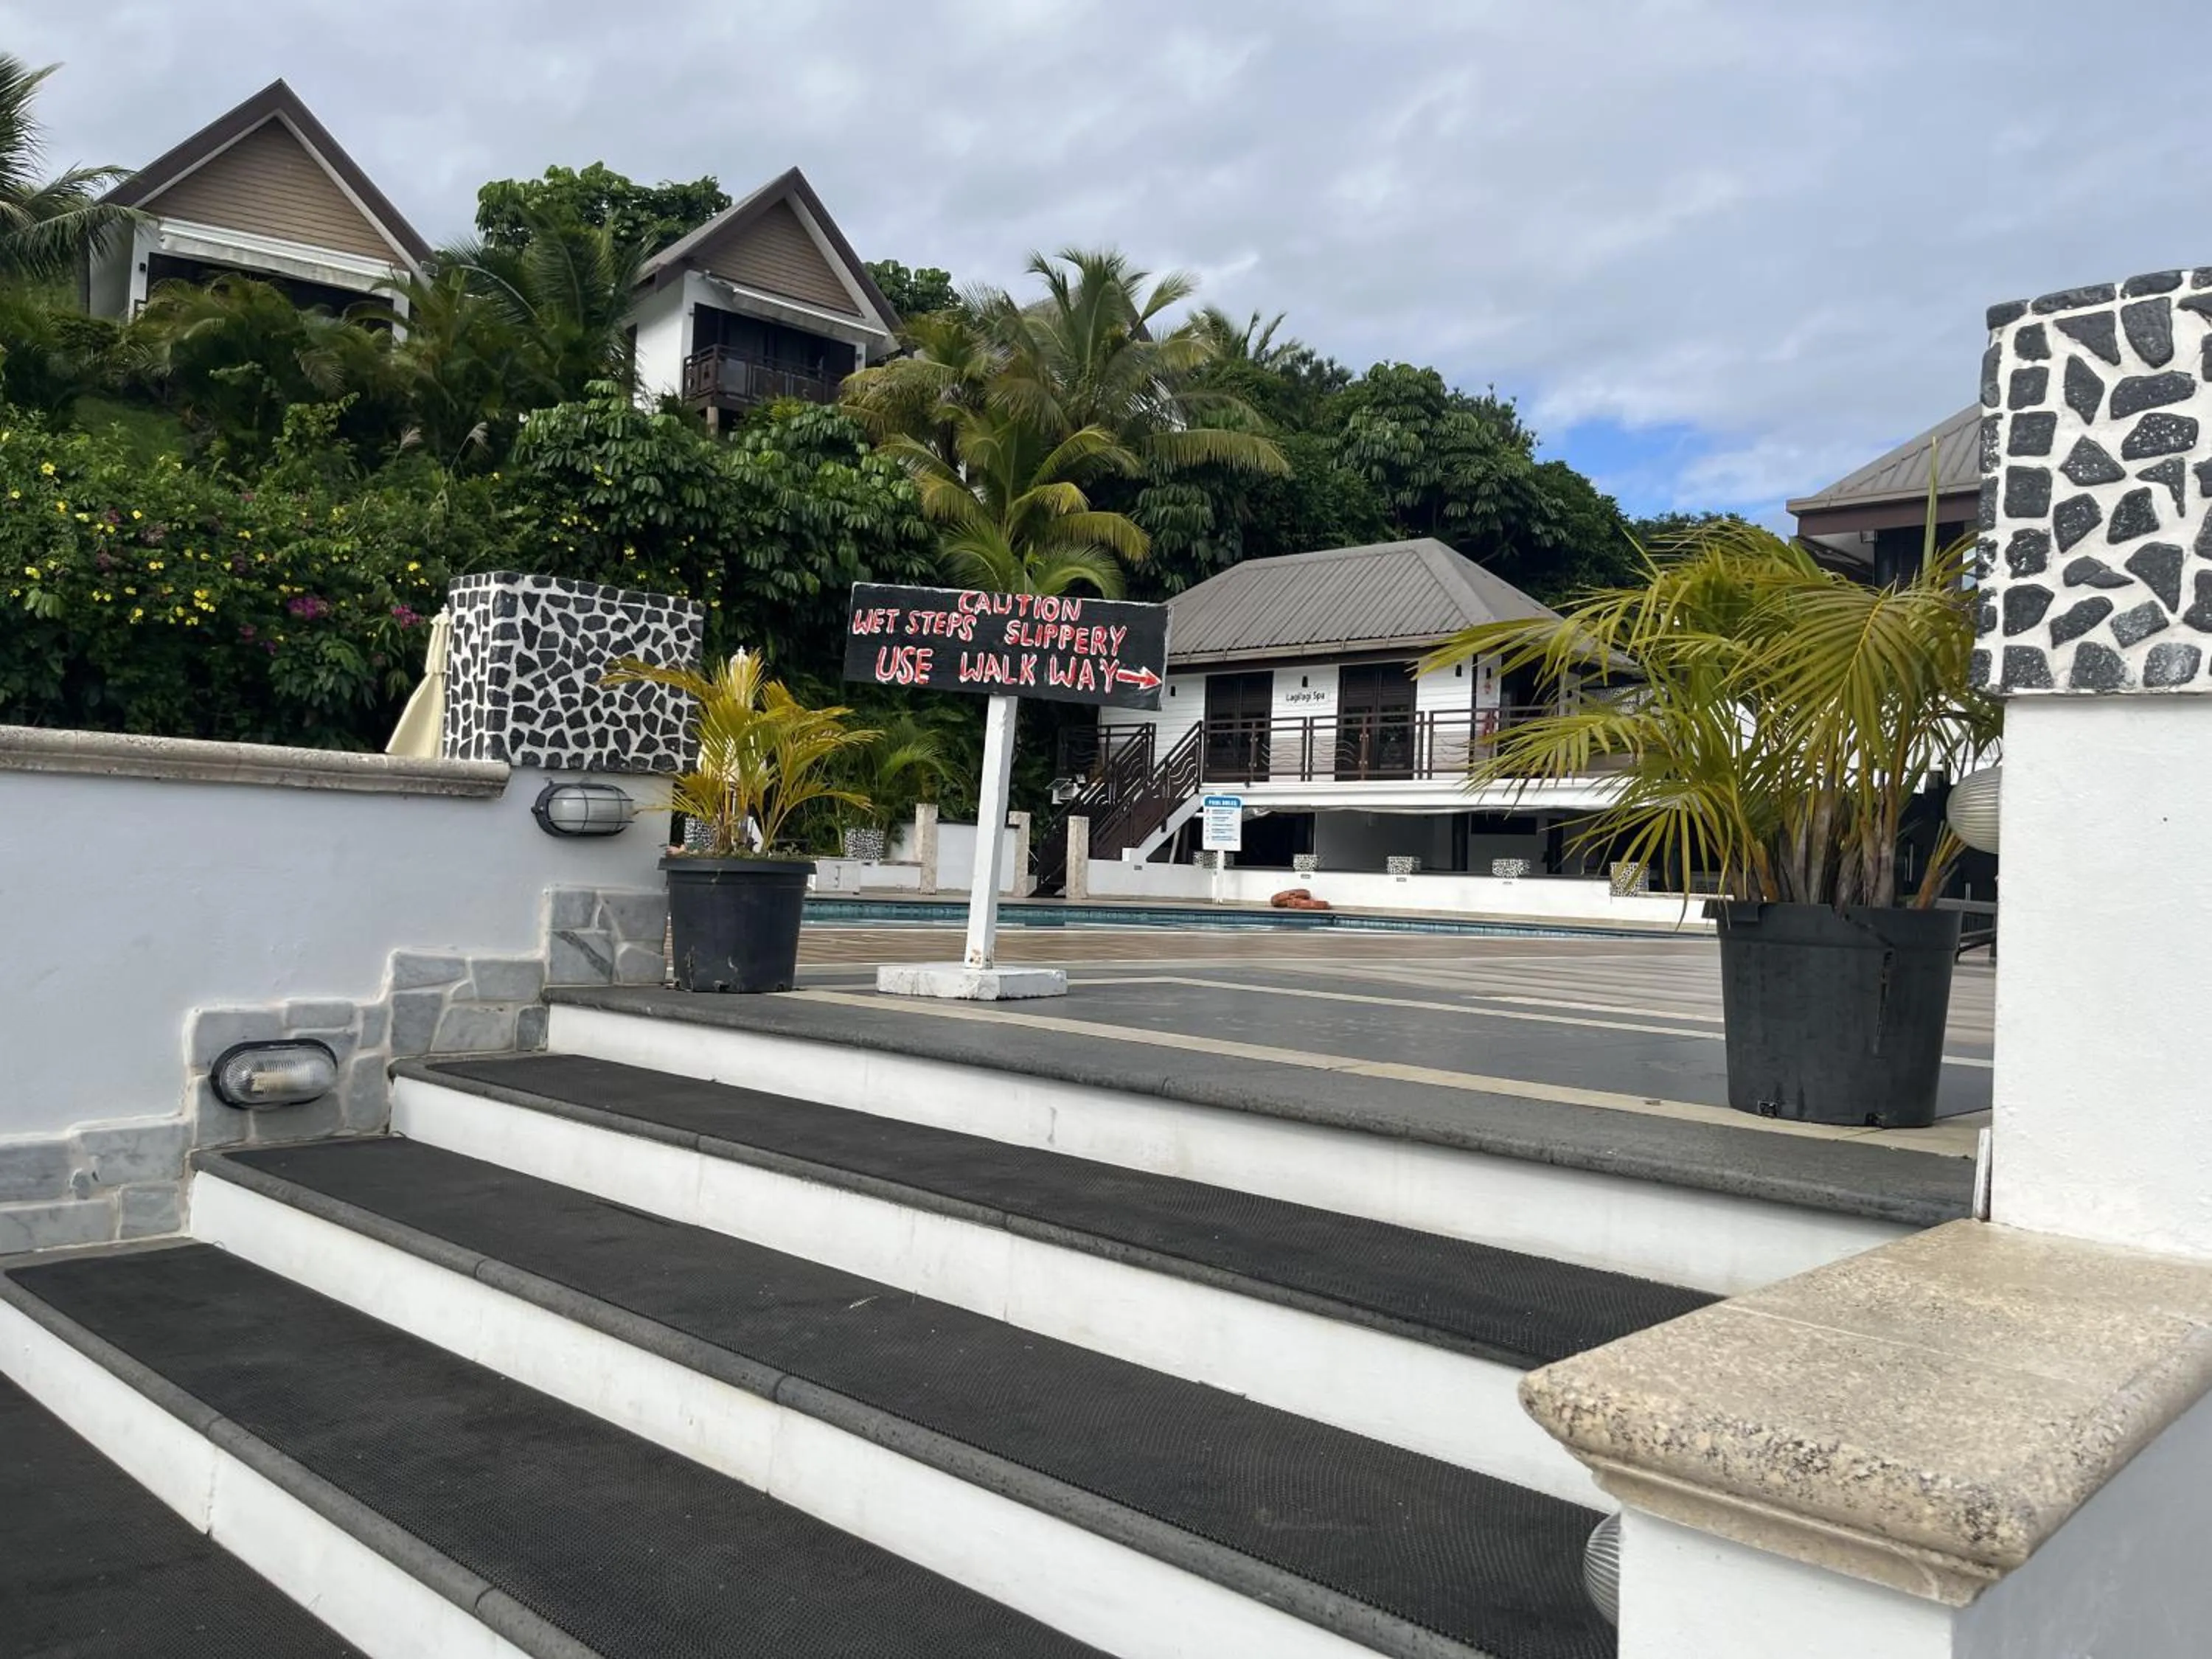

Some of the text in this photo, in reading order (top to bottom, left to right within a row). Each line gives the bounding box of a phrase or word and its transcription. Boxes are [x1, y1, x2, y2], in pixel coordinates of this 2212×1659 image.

[958, 591, 1082, 621] CAUTION
[852, 609, 1127, 656] WET STEPS SLIPPERY
[875, 647, 1119, 694] USE WALK WAY
[1313, 691, 1325, 701] Spa
